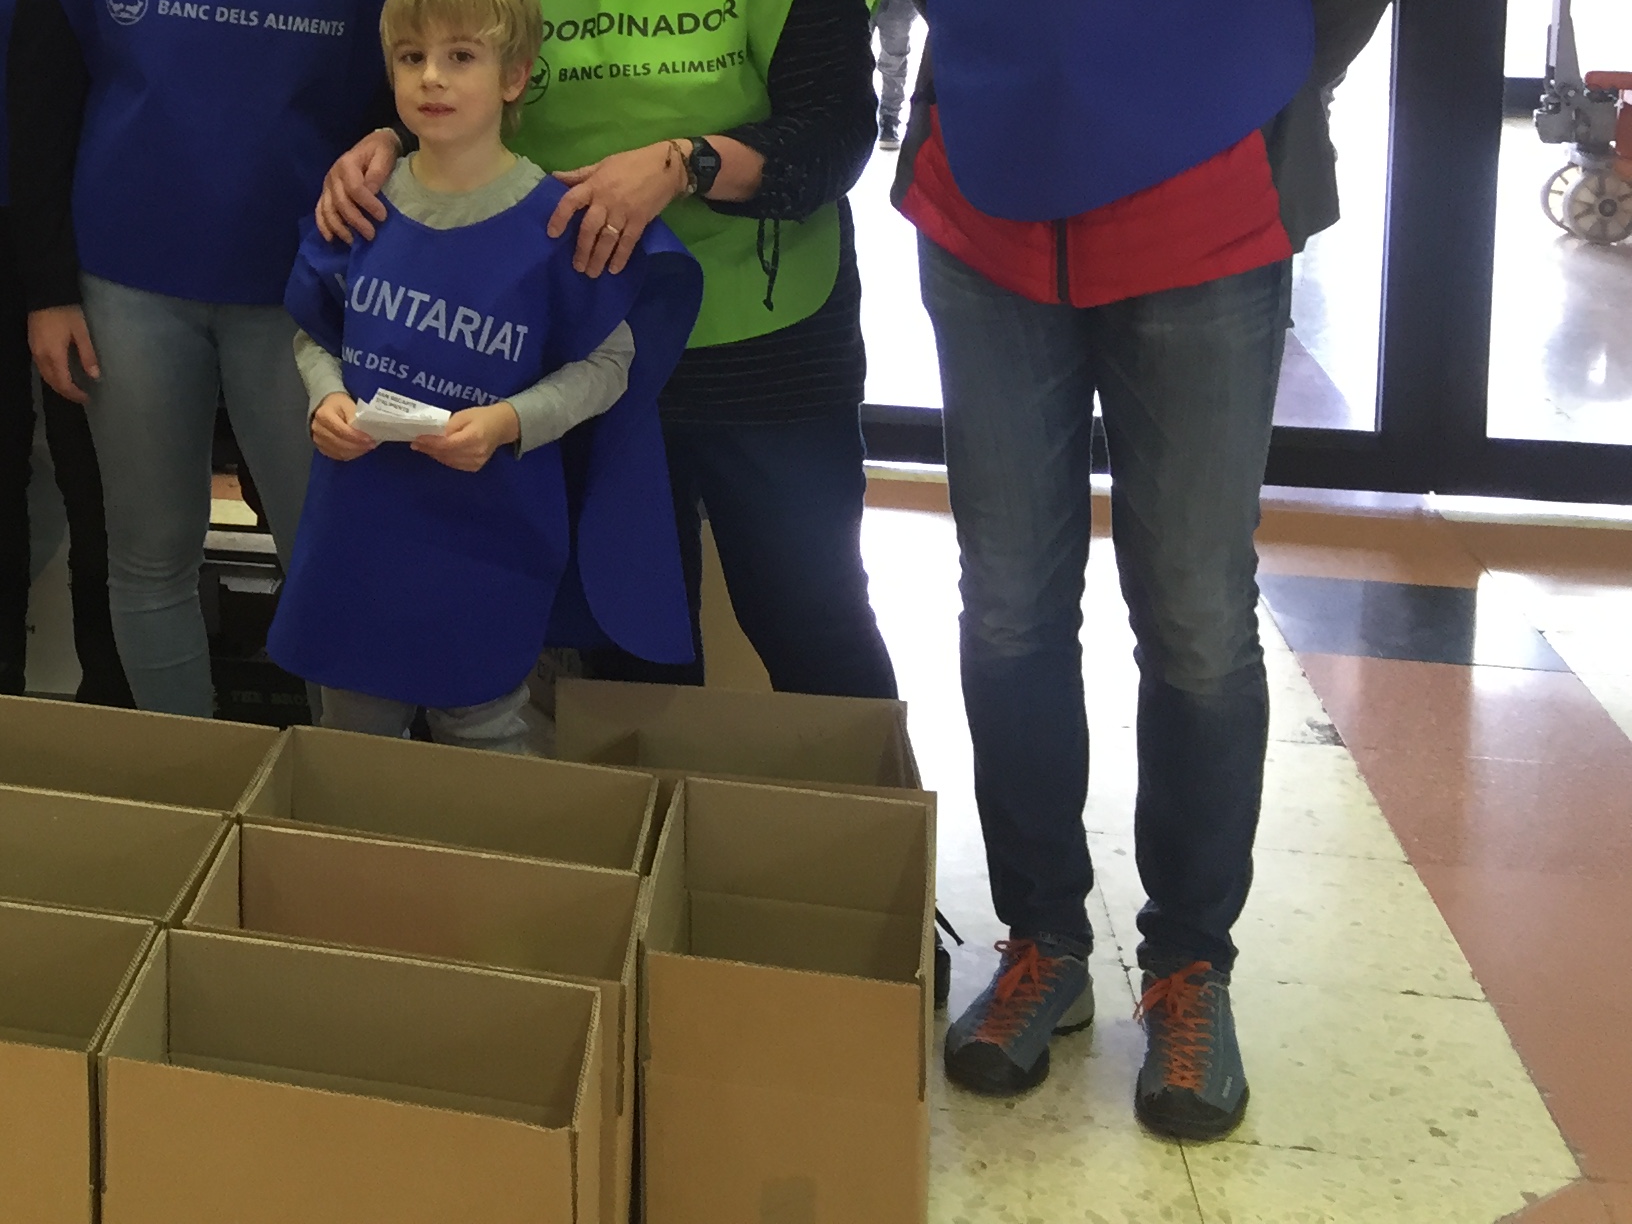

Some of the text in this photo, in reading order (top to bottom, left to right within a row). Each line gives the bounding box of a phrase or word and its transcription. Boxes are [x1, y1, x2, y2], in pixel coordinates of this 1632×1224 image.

[157, 0, 345, 37] BANC DELS ALIMENTS
[558, 49, 745, 82] BANC DELS ALIMENTS
[345, 275, 529, 363] UNTARIAT
[365, 353, 410, 380] DELS
[412, 371, 504, 406] ALIMENT
